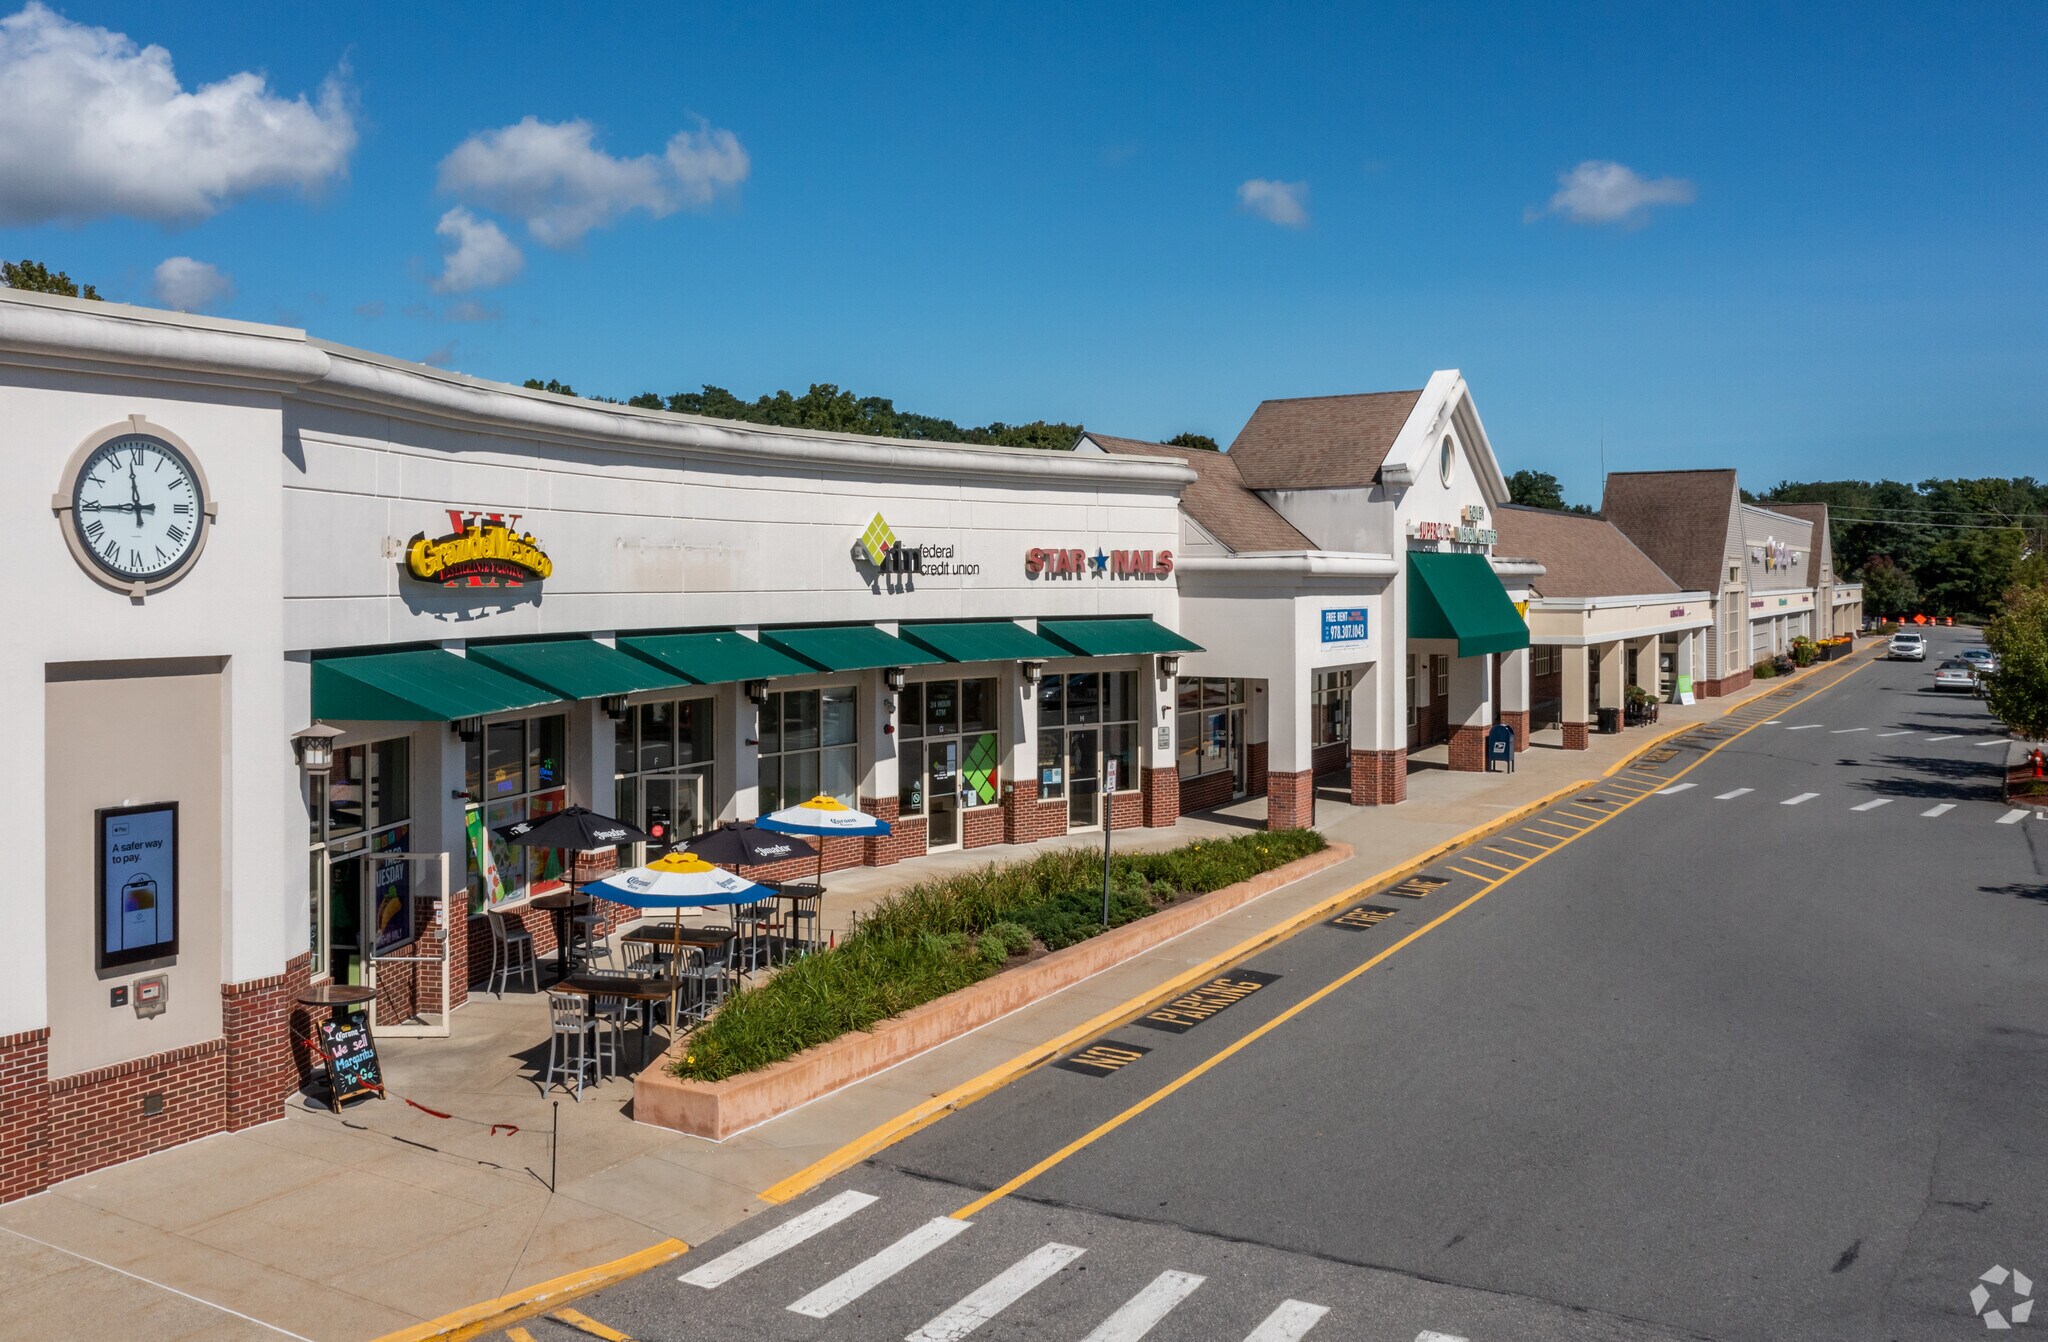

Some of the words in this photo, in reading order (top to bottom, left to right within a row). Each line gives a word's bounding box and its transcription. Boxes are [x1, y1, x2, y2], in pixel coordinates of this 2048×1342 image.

[105, 452, 122, 473] XI
[130, 448, 144, 466] XII
[88, 471, 106, 488] X
[174, 504, 189, 514] III
[131, 549, 143, 567] VI
[155, 545, 167, 561] V
[920, 544, 954, 559] federal
[921, 561, 949, 576] credit
[952, 563, 980, 575] union
[1025, 548, 1087, 573] STAR
[1110, 550, 1174, 573] NAILS
[1326, 612, 1337, 622] FREE
[1337, 611, 1348, 622] RENT
[1330, 624, 1365, 639] 978.307.1043
[654, 757, 659, 766] F
[112, 844, 119, 853] A
[121, 840, 143, 852] safer
[145, 840, 163, 849] way
[112, 855, 121, 864] to
[123, 853, 141, 865] pay.
[376, 863, 404, 888] UESDAY
[1069, 1045, 1144, 1070] NO
[1146, 978, 1263, 1026] PARKING
[1332, 907, 1396, 928] FIRE
[1388, 878, 1449, 897] LANE
[335, 1029, 359, 1041] Corona
[332, 1044, 348, 1058] We
[353, 1034, 368, 1051] sell
[345, 1073, 357, 1085] To
[360, 1068, 374, 1081] Go
